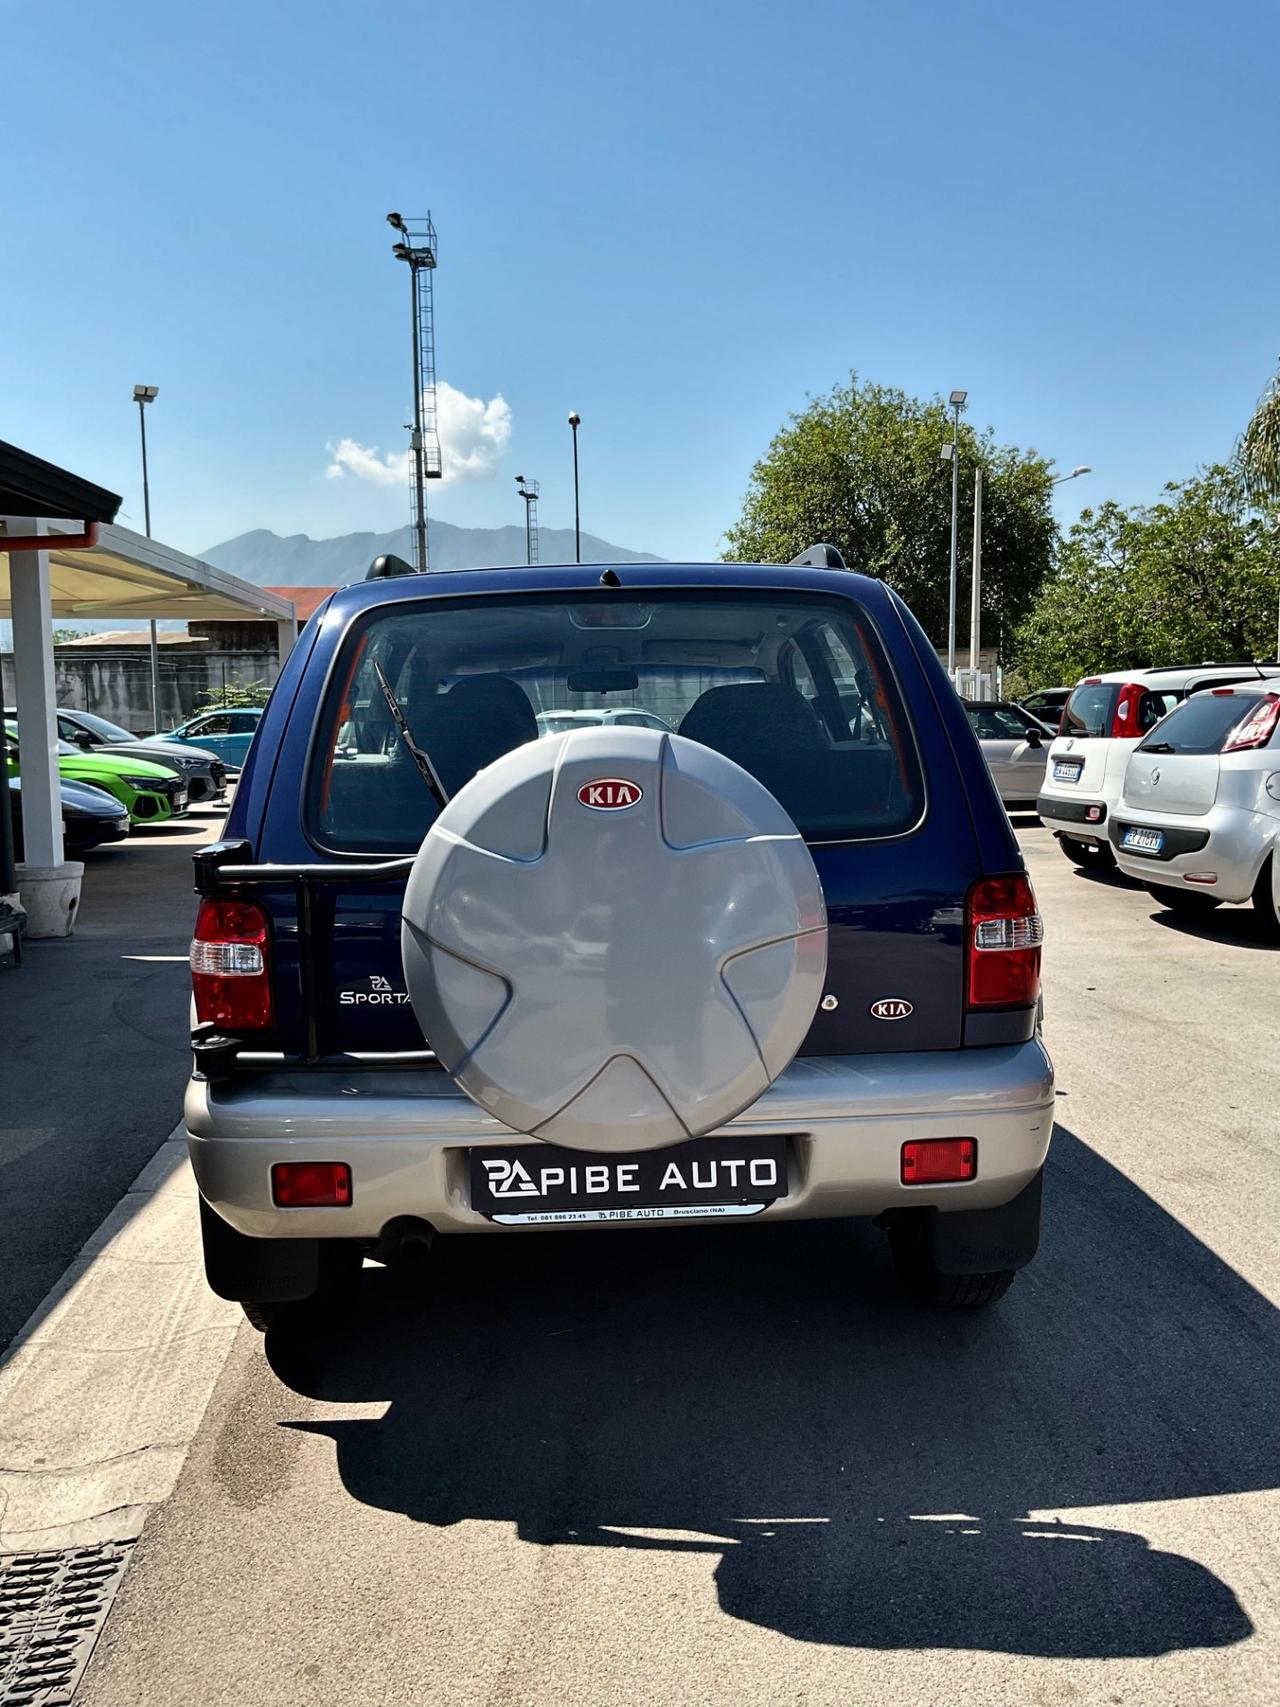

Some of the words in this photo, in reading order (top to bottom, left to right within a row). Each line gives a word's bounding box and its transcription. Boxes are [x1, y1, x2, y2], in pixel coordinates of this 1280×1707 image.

[588, 786, 633, 804] KIA
[878, 1003, 907, 1016] KIA
[540, 1163, 641, 1196] PIBE
[658, 1158, 778, 1191] AUTO
[609, 1210, 633, 1218] PIBE
[636, 1209, 664, 1217] AUTO
[673, 1207, 709, 1215] Brusciano
